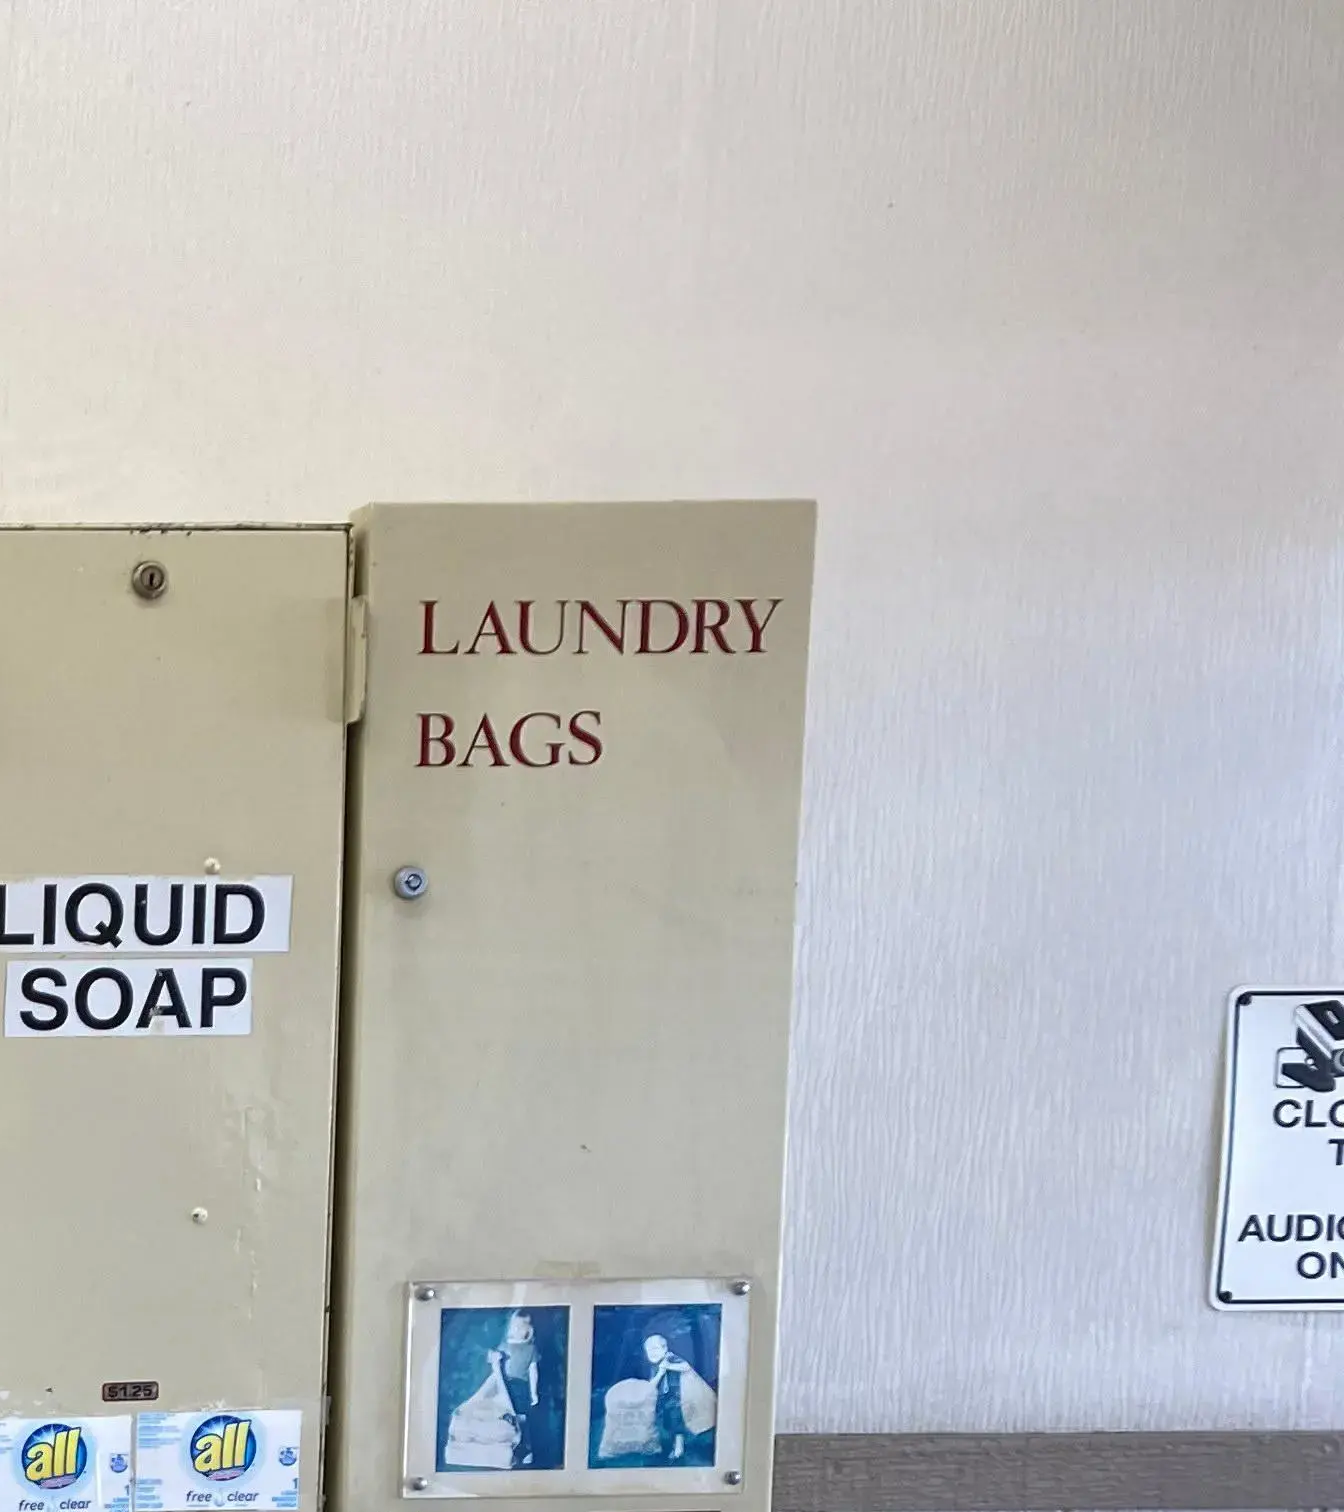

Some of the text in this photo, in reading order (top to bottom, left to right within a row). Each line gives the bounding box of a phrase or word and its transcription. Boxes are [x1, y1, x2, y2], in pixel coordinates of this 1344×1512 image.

[417, 598, 784, 656] LAUNDRY
[414, 710, 604, 768] BAGS
[19, 966, 248, 1031] SOAP
[1237, 1214, 1344, 1243] AUDI
[108, 1385, 153, 1398] $1.25
[25, 1426, 82, 1483] all
[194, 1419, 252, 1475] all
[18, 1498, 92, 1512] free clear
[186, 1490, 260, 1504] free clear
